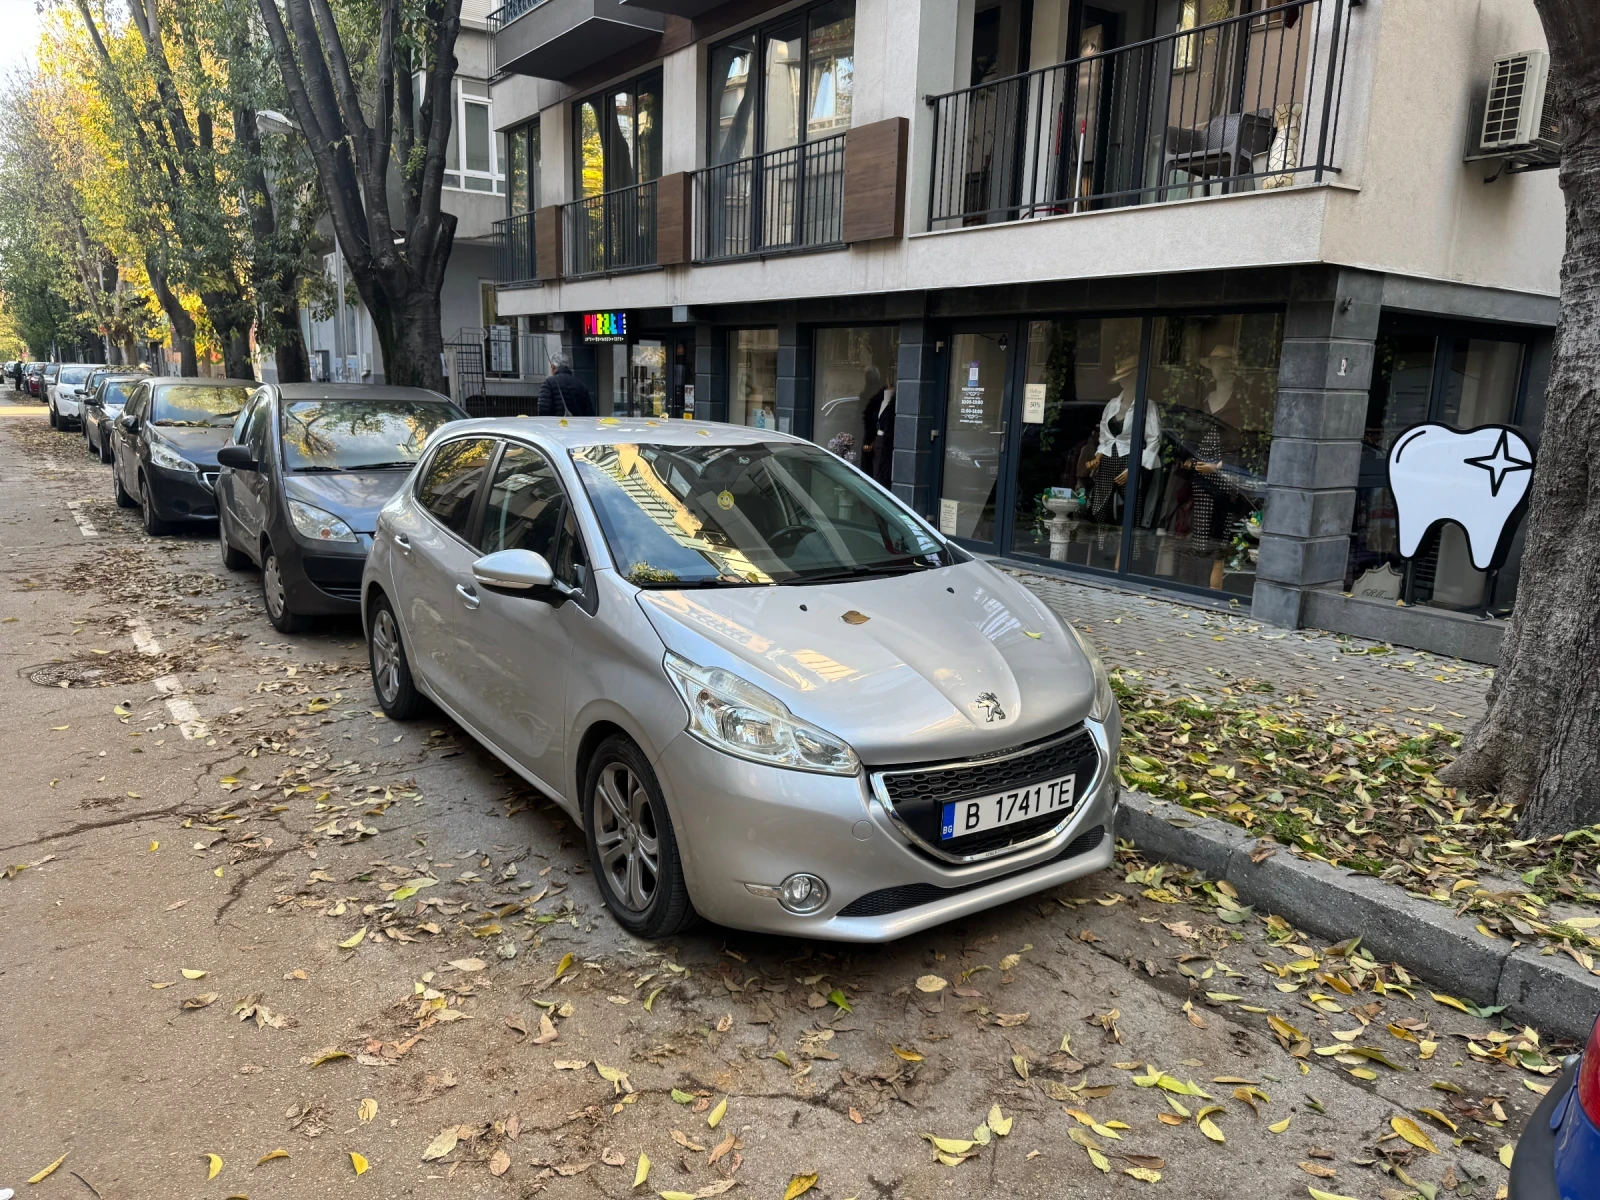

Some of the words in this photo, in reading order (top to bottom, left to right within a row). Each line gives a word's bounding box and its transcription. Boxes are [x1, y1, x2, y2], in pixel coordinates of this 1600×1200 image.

[965, 802, 980, 830] B
[996, 786, 1041, 823] 1741
[1047, 778, 1071, 809] TE
[942, 825, 953, 835] BG
